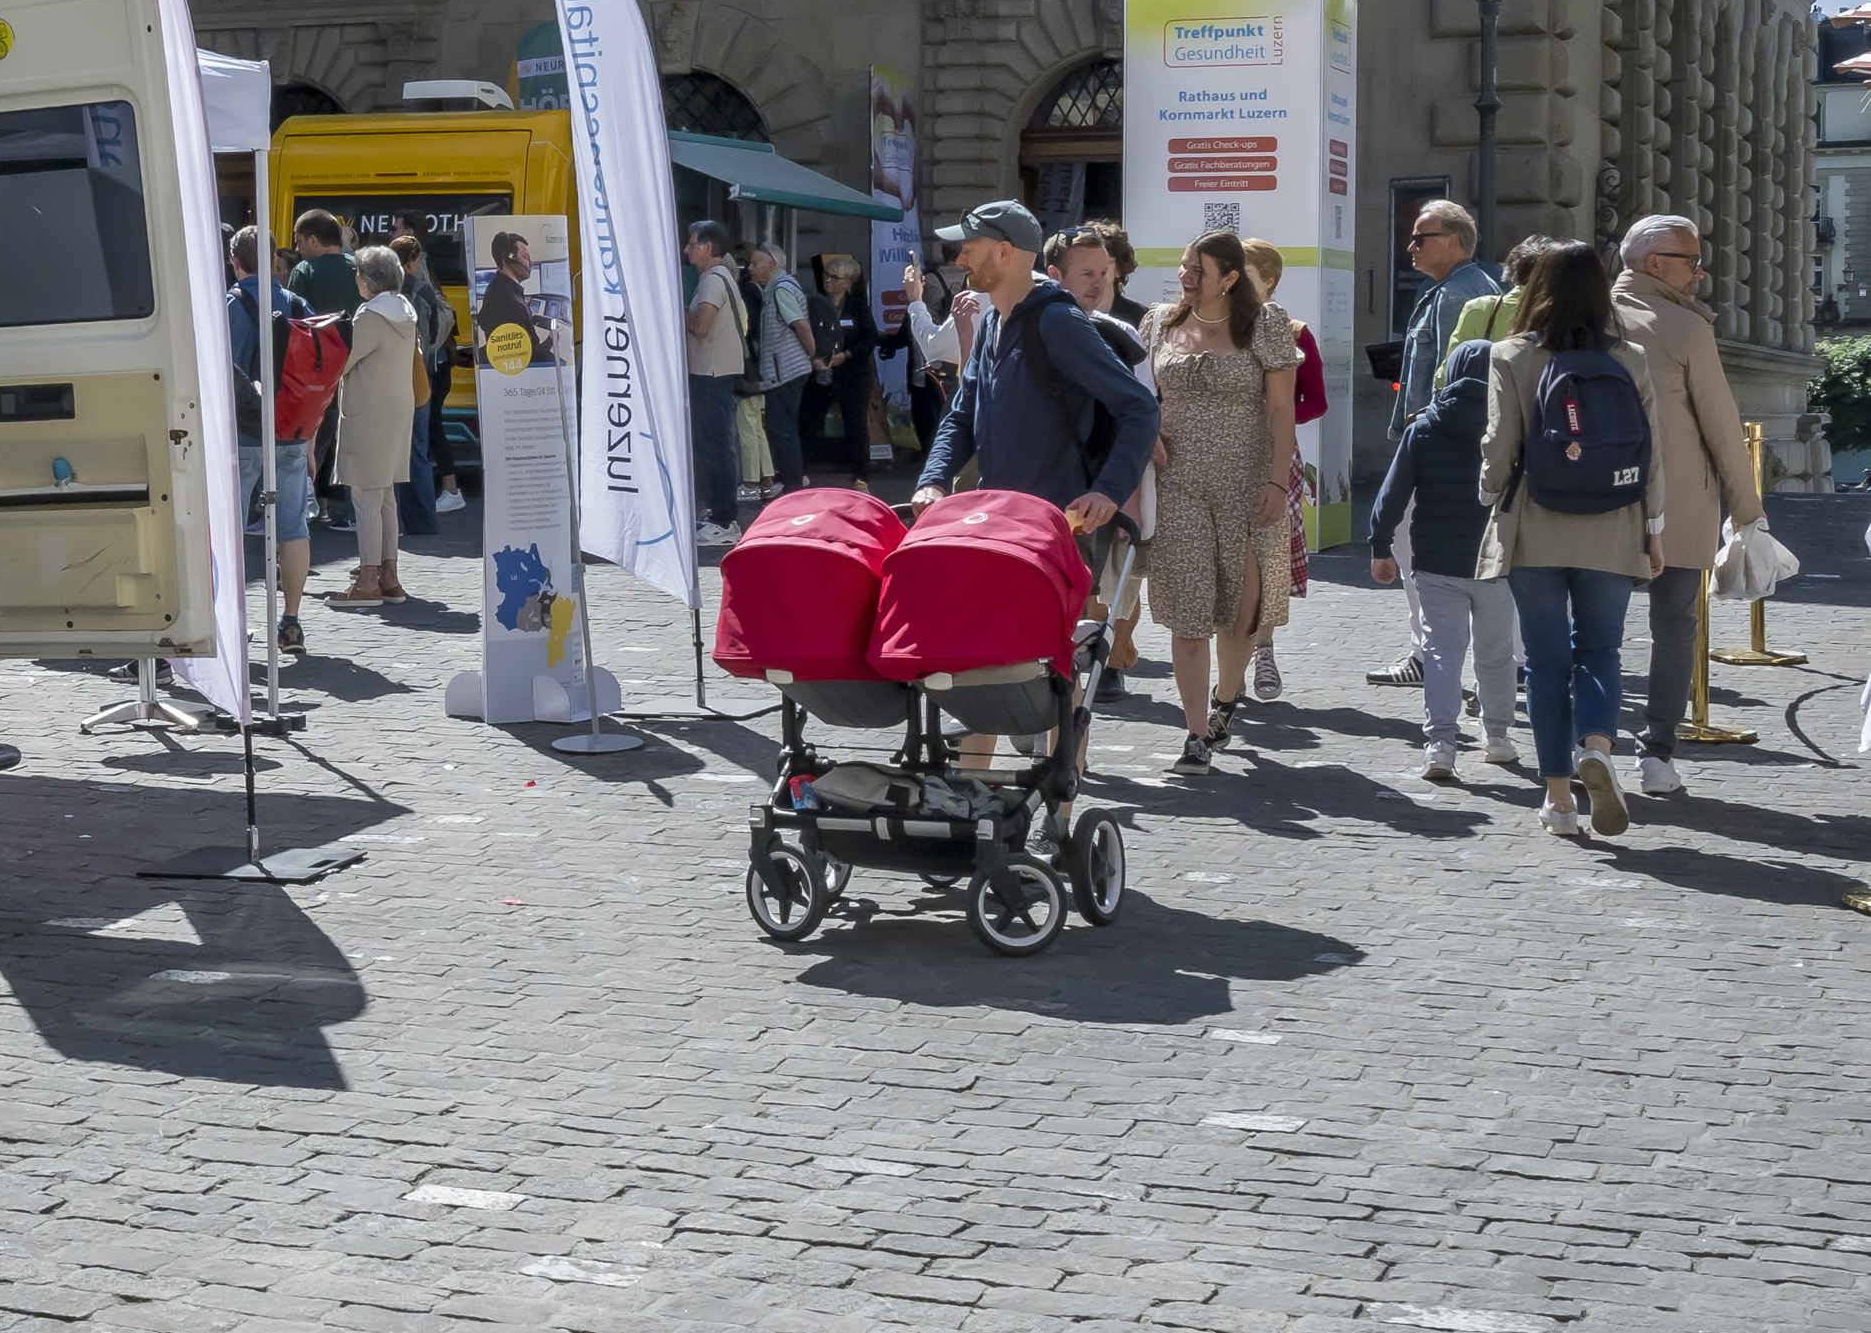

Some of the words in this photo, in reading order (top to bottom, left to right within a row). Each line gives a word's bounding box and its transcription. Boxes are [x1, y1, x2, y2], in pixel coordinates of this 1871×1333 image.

[1175, 24, 1264, 41] Treffpunkt
[1270, 16, 1283, 65] Luzern
[1175, 45, 1265, 61] Gesundheit
[1179, 90, 1235, 102] Rathaus
[1240, 89, 1267, 101] und
[1159, 108, 1235, 120] Kornmarkt
[1239, 108, 1287, 119] Luzern
[1187, 141, 1211, 149] Gratis
[1213, 140, 1258, 150] Check-ups
[1174, 161, 1198, 170] Gratis
[1200, 160, 1270, 170] Fachberatungen
[1194, 180, 1218, 188] Freier
[1220, 180, 1249, 188] Eintritt
[361, 214, 467, 233] NEOTH
[497, 340, 522, 352] notruf
[502, 358, 523, 372] 144
[504, 388, 518, 396] 365
[1613, 467, 1639, 486] L27
